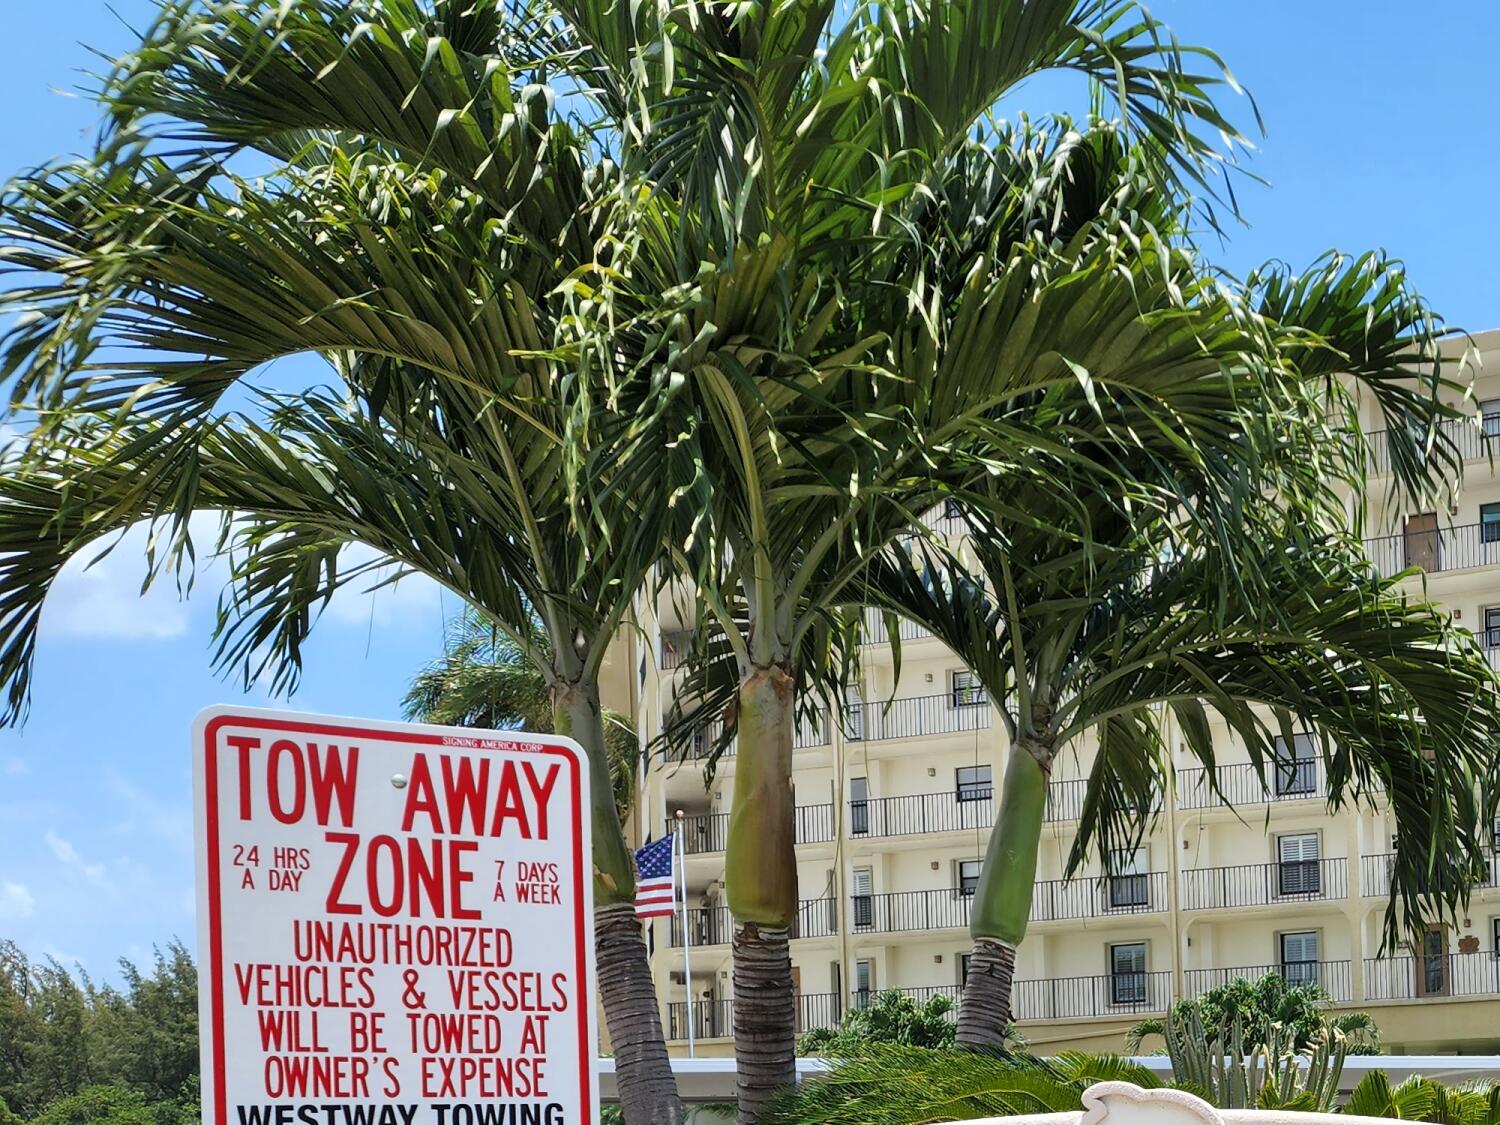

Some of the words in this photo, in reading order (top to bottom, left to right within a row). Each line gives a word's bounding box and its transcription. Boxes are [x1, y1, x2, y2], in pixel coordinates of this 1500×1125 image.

[442, 736, 477, 748] SIGNING
[480, 739, 518, 752] AMERICA
[226, 735, 359, 828] TOW
[401, 752, 561, 840] AWAY
[232, 844, 260, 867] 24
[274, 847, 310, 870] HRS
[324, 831, 482, 920] ZONE
[494, 860, 505, 881] 7
[518, 862, 559, 883] DAYS
[241, 868, 255, 890] A
[269, 870, 303, 892] DAY
[493, 881, 505, 902] A
[515, 882, 561, 905] WEEK
[294, 919, 513, 968] UNAUTHORIZED
[234, 963, 375, 1009] VEHICLES
[401, 968, 426, 1009] &
[447, 970, 568, 1013] VESSELS
[257, 1010, 329, 1053] WILL
[350, 1012, 387, 1053] BE
[406, 1013, 501, 1054] TOWED
[520, 1015, 549, 1054] AT
[264, 1055, 400, 1099] OWNER'S
[422, 1057, 549, 1098] EXPENSE
